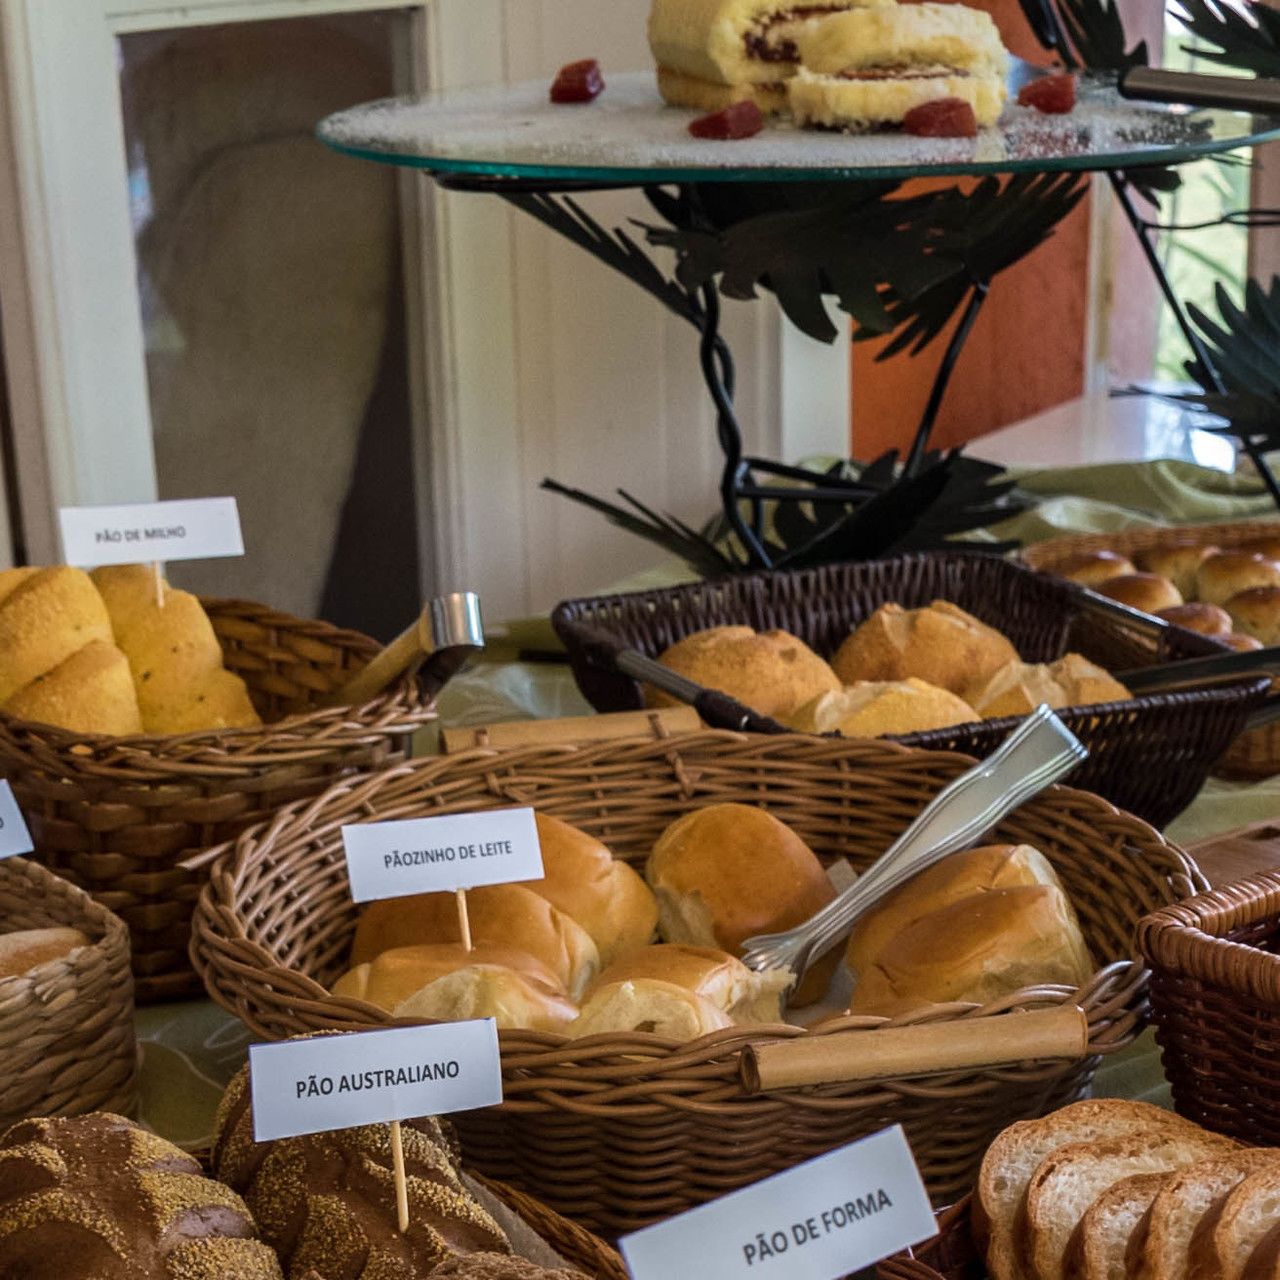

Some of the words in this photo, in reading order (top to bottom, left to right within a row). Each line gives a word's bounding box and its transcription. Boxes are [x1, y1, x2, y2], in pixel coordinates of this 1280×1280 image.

[95, 528, 122, 543] PÃO
[124, 529, 141, 541] DE
[144, 526, 187, 540] MILHO
[383, 847, 456, 868] PÃOZINHO
[459, 845, 476, 860] DE
[479, 840, 513, 857] LEITE
[296, 1074, 333, 1098] PÃO
[338, 1061, 460, 1093] AUSTRALIANO
[742, 1231, 788, 1265] PÃO
[792, 1217, 821, 1246] DE
[821, 1188, 893, 1234] FORMA
